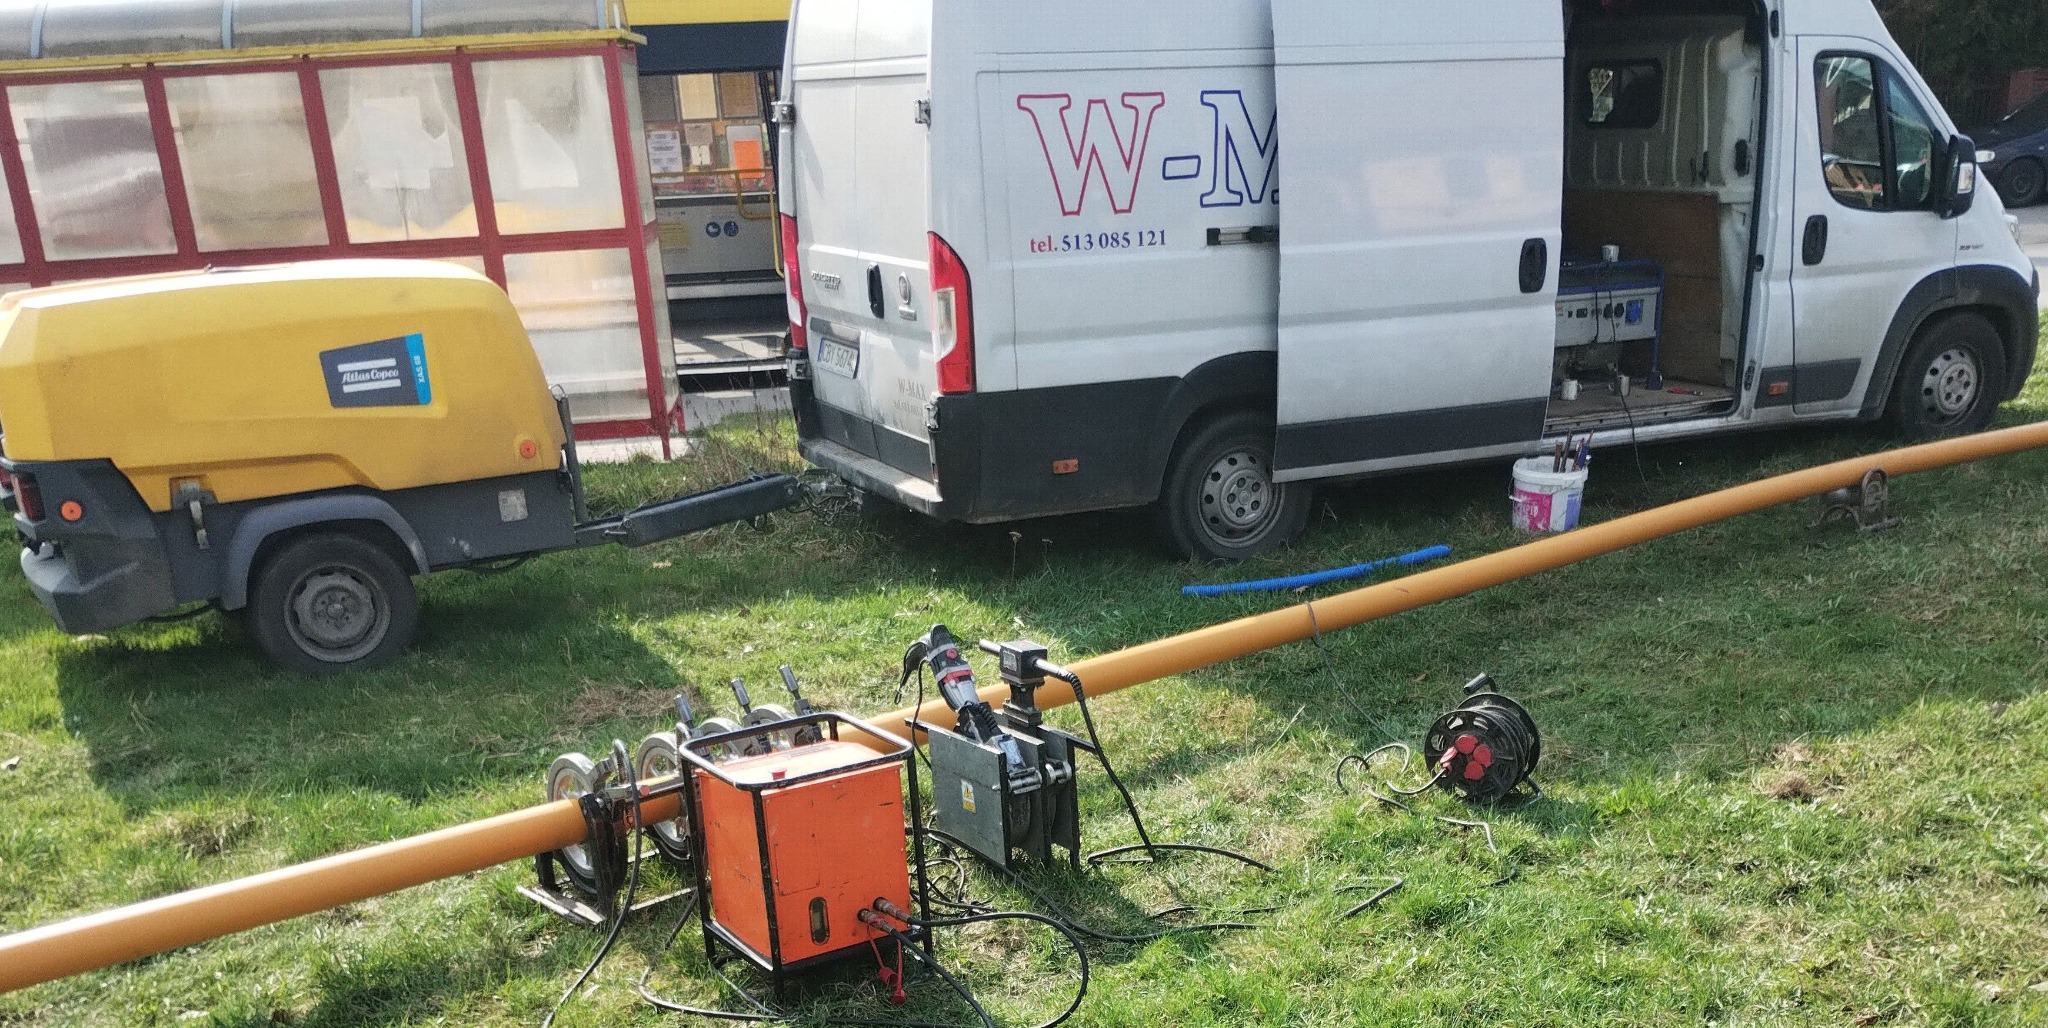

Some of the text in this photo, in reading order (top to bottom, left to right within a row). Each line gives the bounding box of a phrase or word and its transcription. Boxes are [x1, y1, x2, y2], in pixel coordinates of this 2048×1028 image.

[1030, 229, 1166, 253] tel. 513 085 121
[341, 368, 399, 384] Atlas Copco
